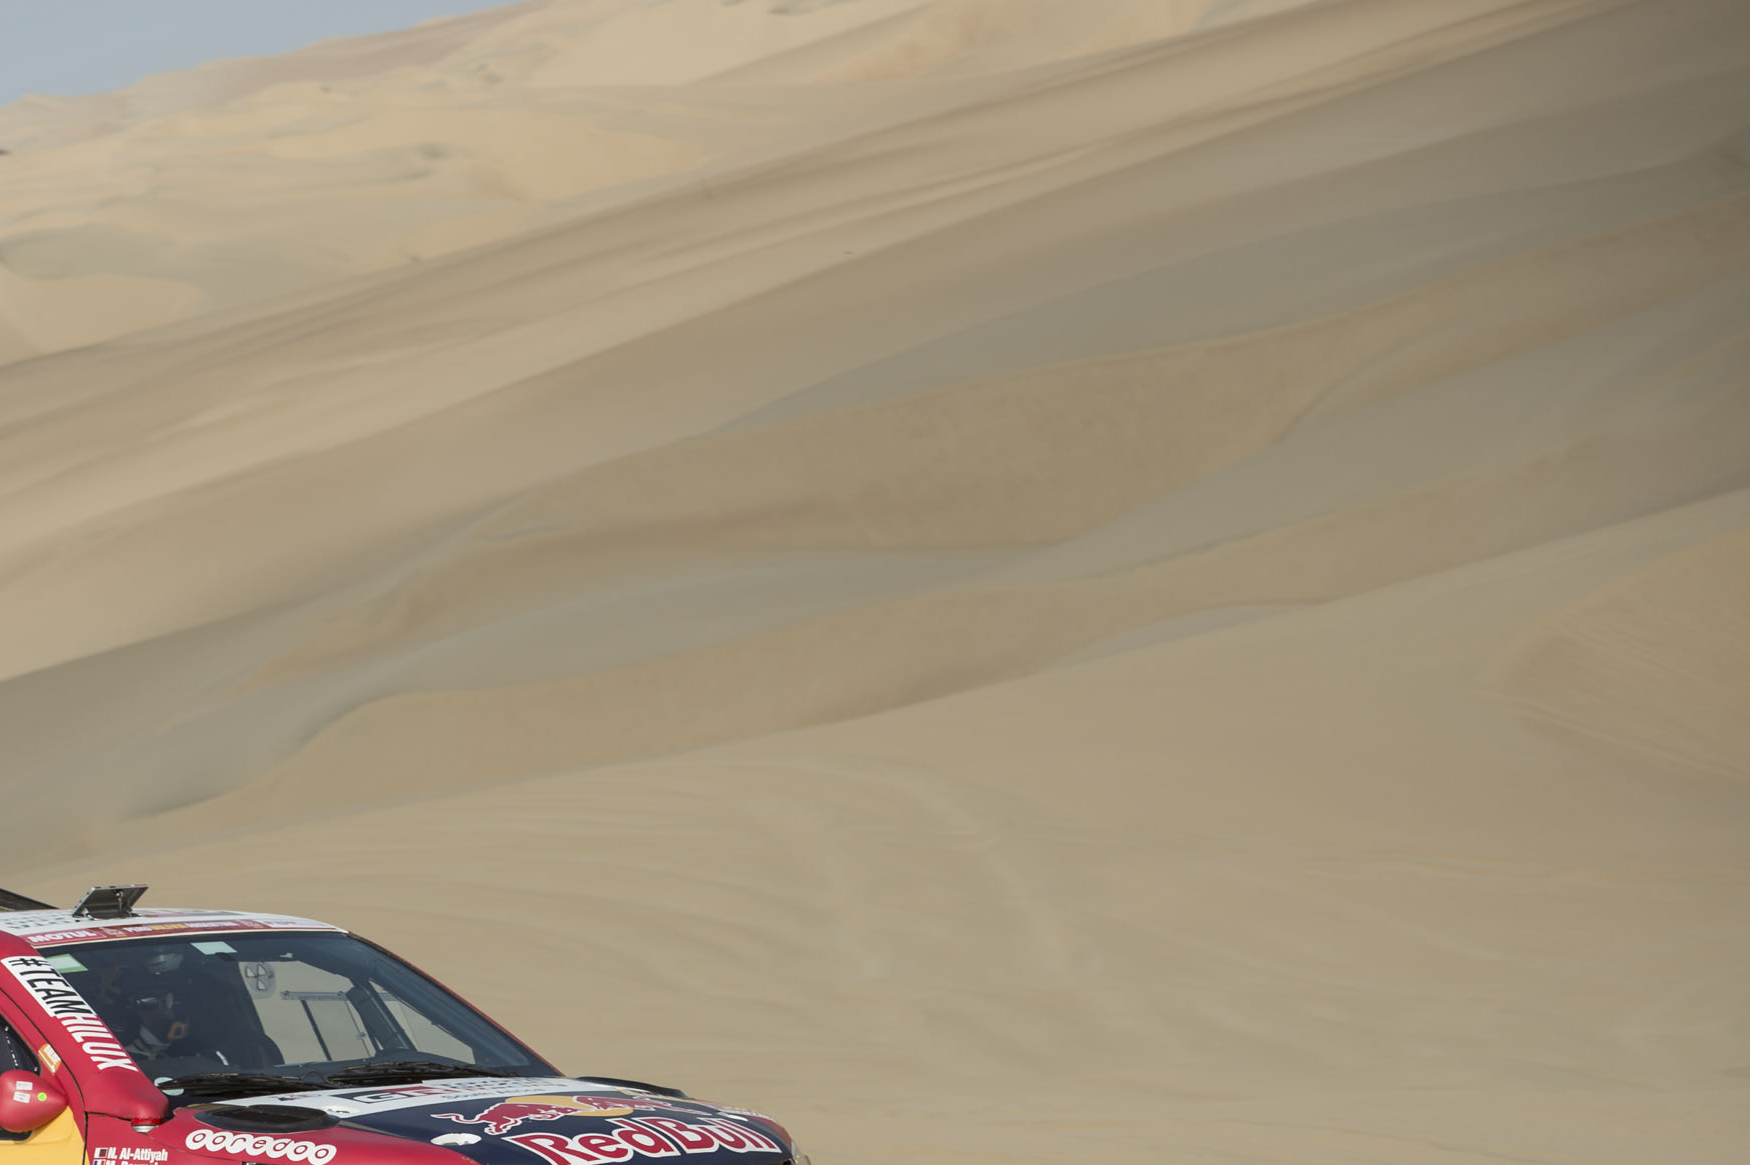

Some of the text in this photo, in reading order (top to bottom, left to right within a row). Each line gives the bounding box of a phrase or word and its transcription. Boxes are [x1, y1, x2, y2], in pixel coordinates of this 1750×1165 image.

[28, 930, 97, 943] MOTUL
[185, 1129, 337, 1165] ooredoo
[634, 1116, 783, 1155] Bull
